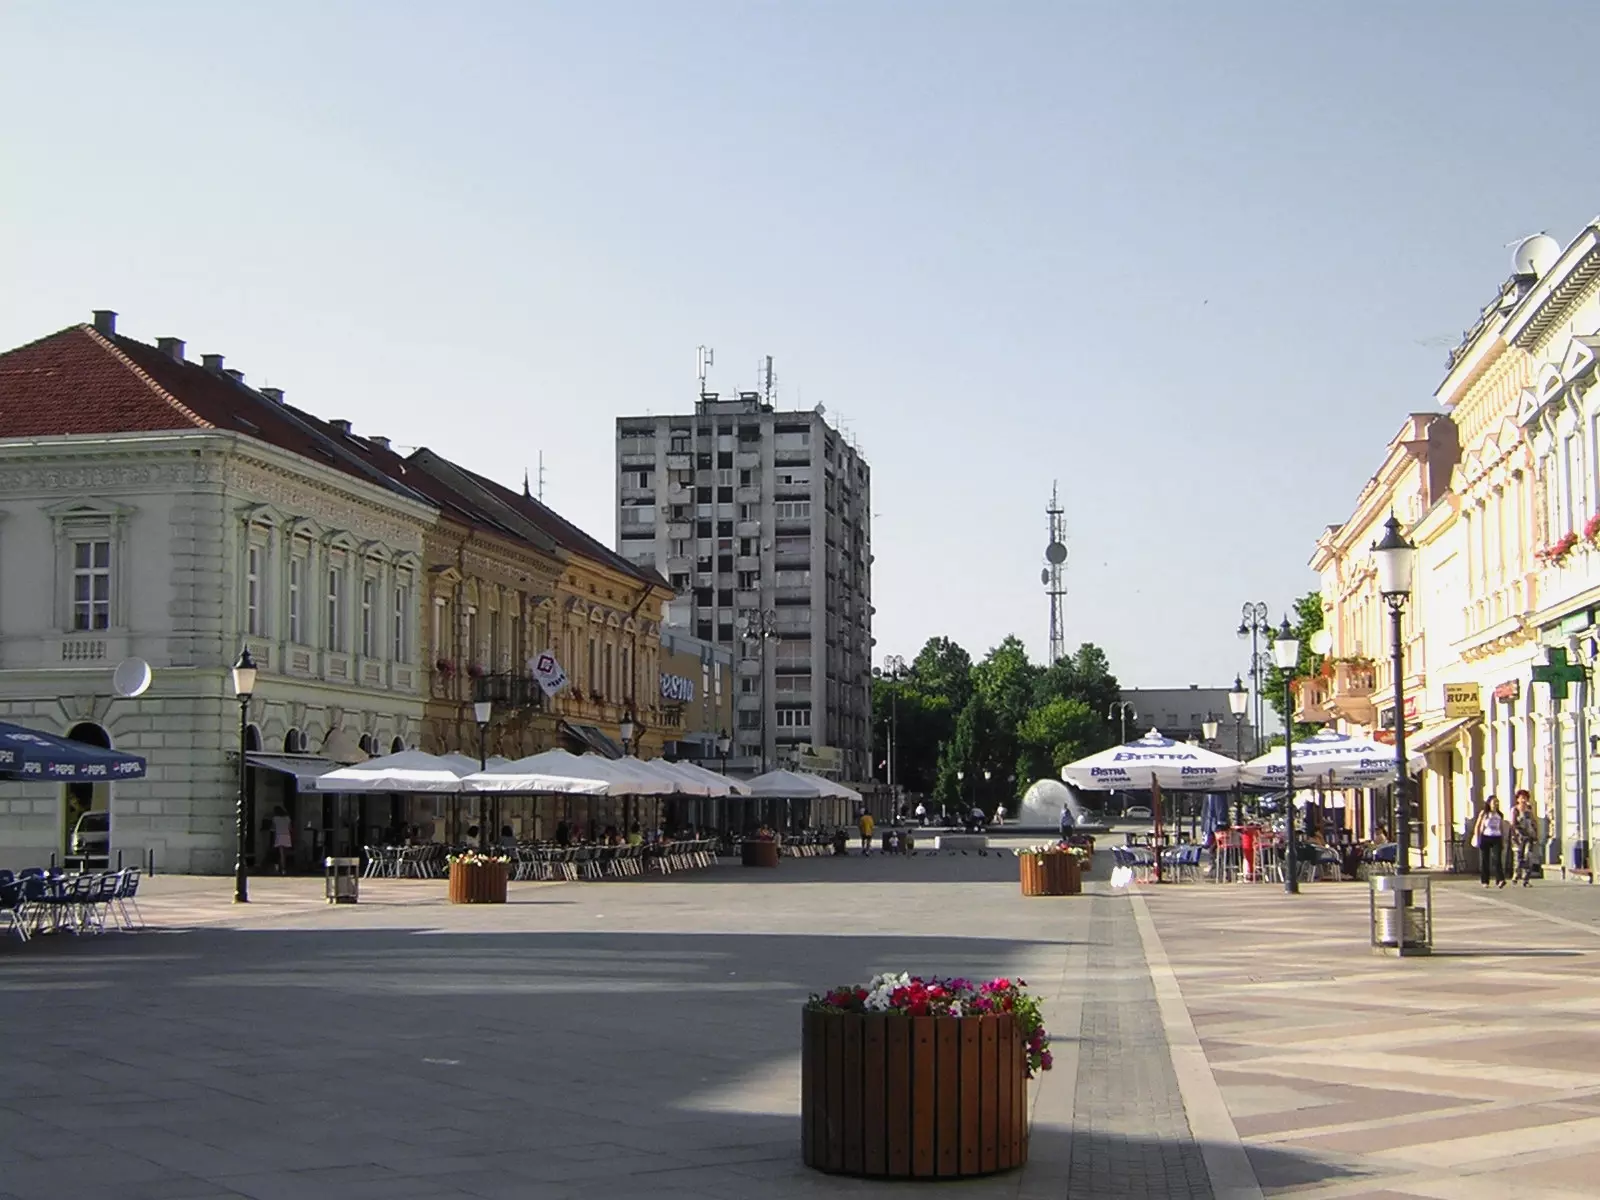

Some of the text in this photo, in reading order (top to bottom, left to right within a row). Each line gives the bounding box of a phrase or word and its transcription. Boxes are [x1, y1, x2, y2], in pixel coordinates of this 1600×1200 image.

[1447, 693, 1478, 703] RUPA
[1113, 752, 1198, 762] BISTRA
[54, 764, 76, 775] PEPSI
[1091, 767, 1127, 777] BISTRA
[1181, 766, 1218, 775] BISTRA
